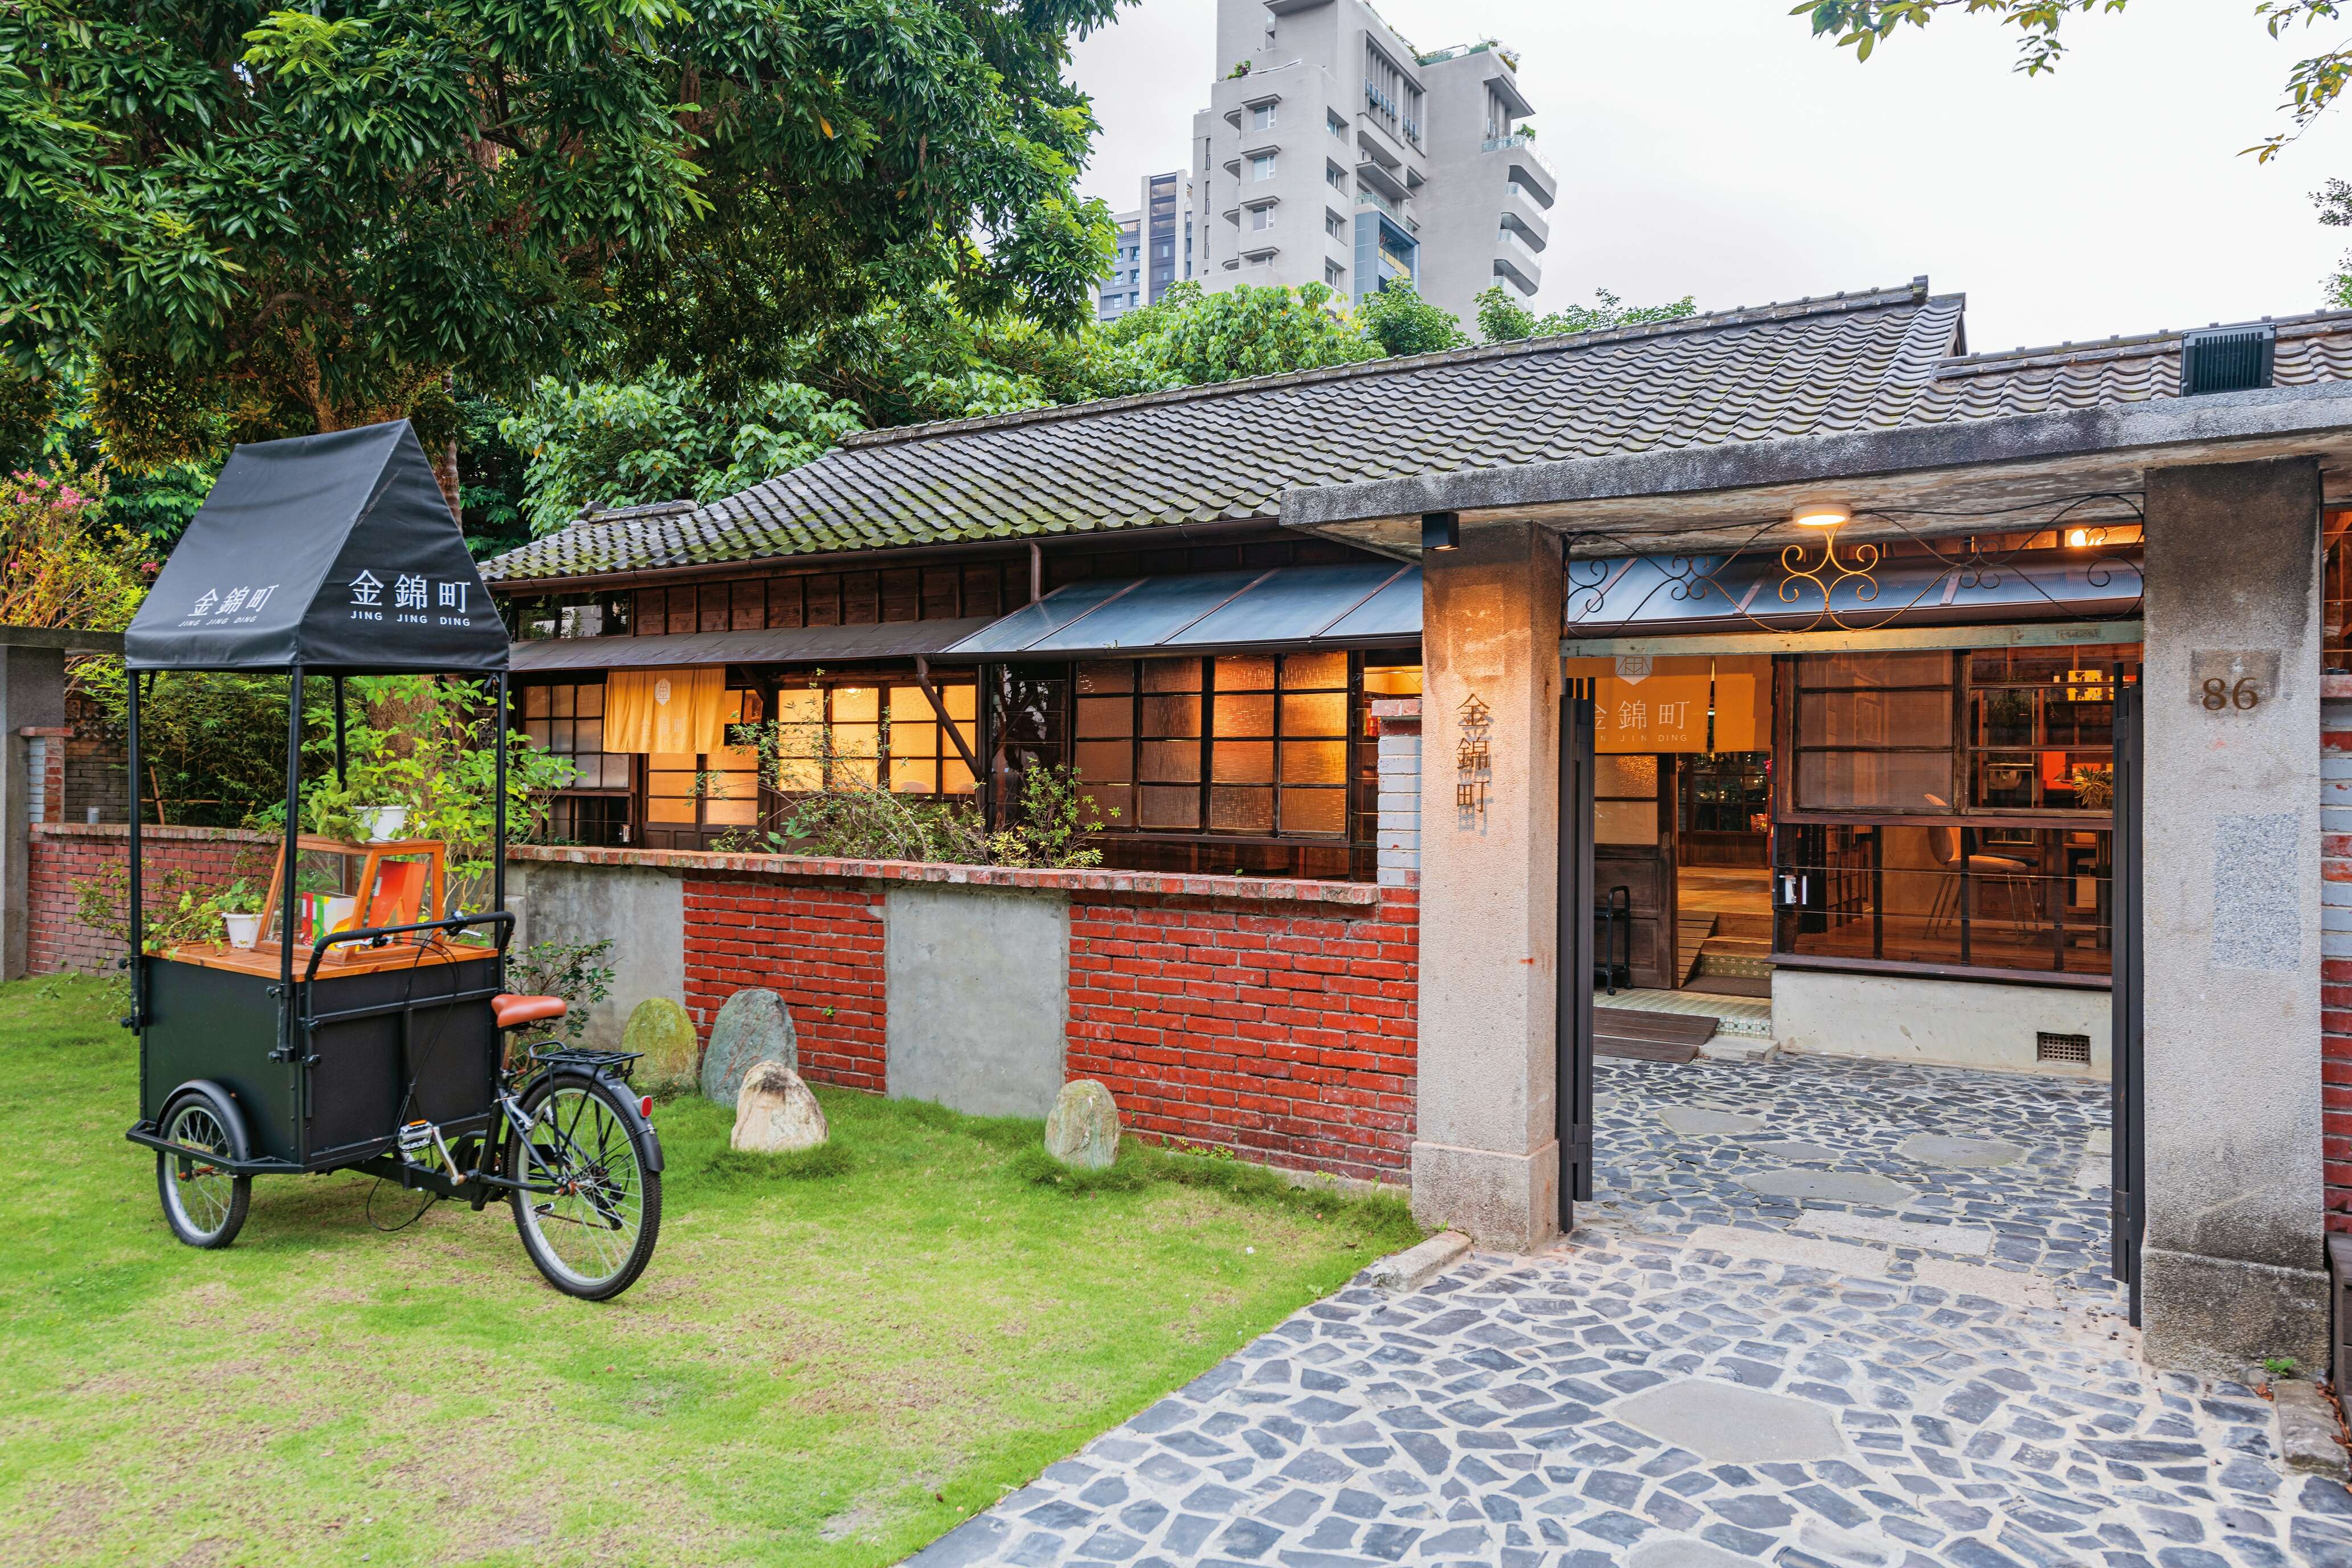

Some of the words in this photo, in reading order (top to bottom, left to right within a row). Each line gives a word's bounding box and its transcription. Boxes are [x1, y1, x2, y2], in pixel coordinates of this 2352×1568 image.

[187, 583, 280, 616] 金錦町
[348, 569, 471, 613] 金錦町
[350, 610, 383, 620] JING
[396, 614, 428, 624] JING
[439, 616, 470, 626] DING
[2203, 677, 2258, 710] 86
[1456, 693, 1491, 812] 金錦町
